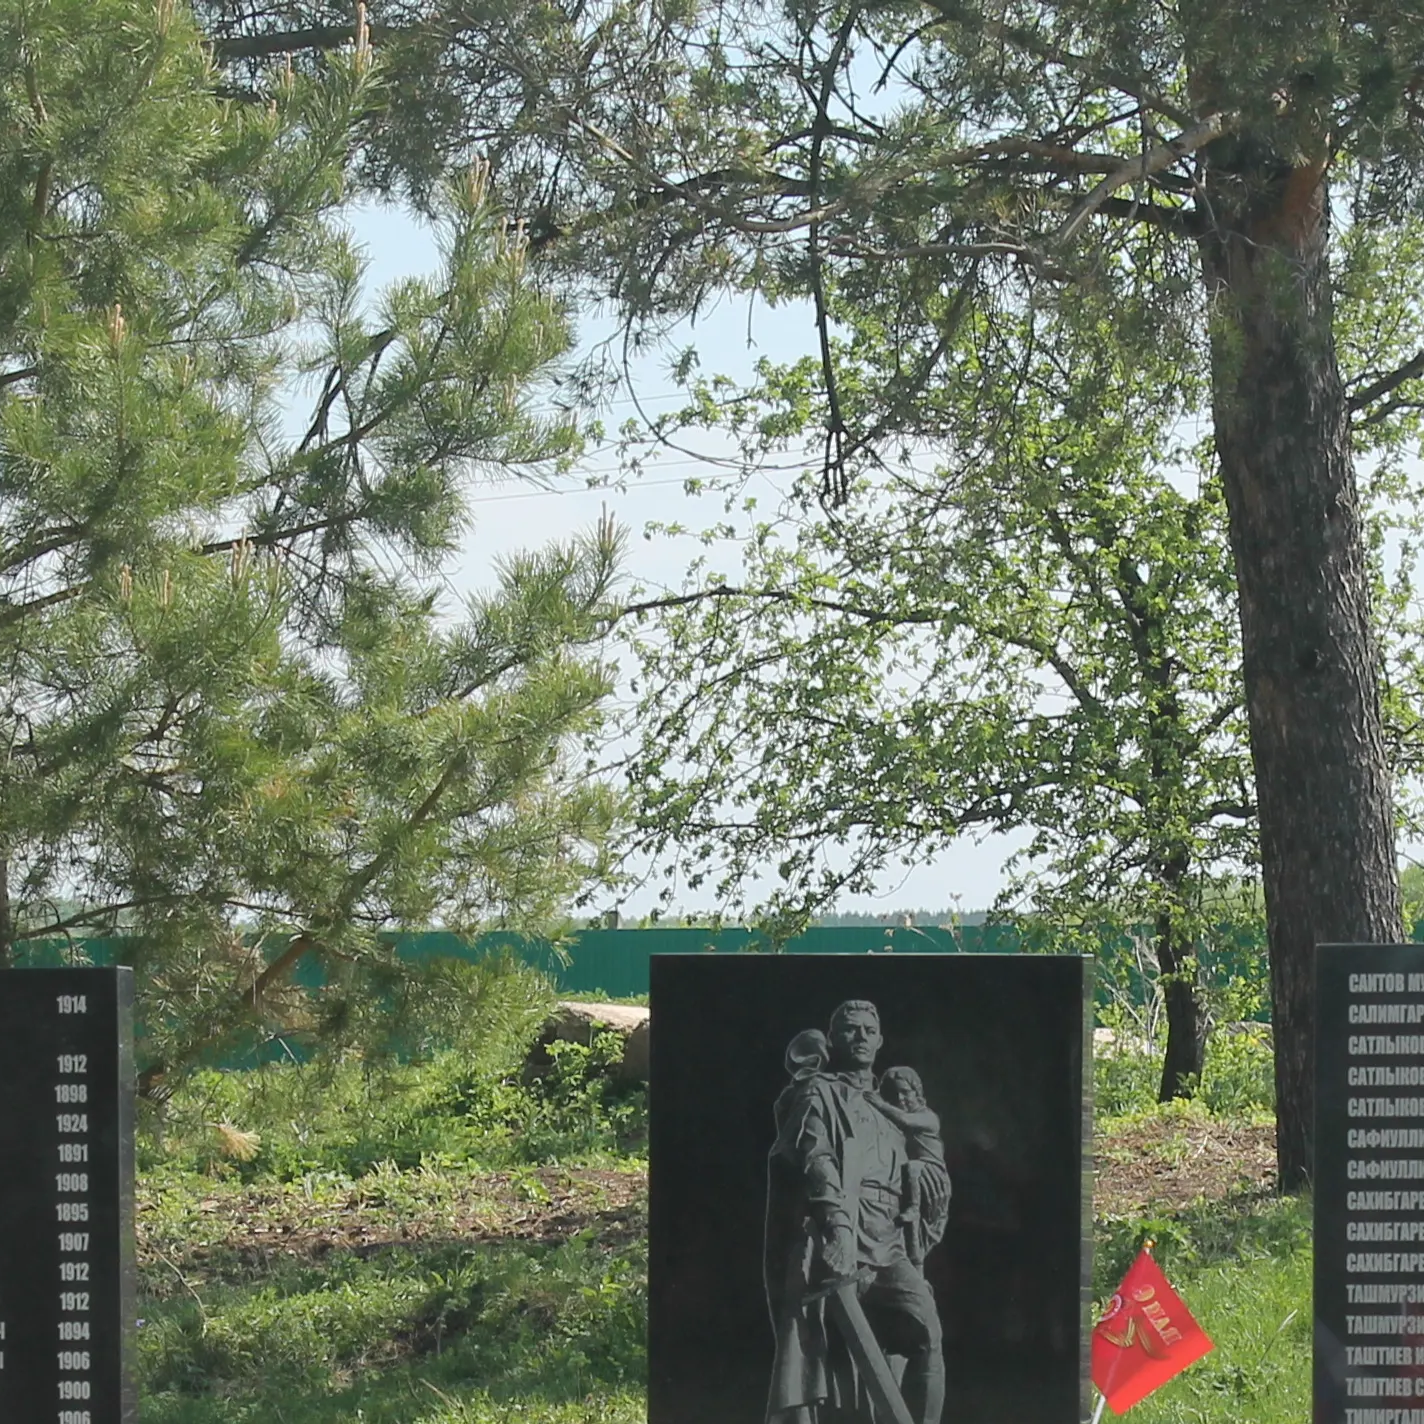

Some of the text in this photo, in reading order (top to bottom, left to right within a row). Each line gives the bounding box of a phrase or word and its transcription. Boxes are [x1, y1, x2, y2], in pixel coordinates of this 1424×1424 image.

[57, 995, 86, 1013] 1914
[57, 1114, 88, 1132] 1924
[56, 1173, 88, 1191] 1908
[59, 1233, 89, 1251] 1907
[58, 1351, 90, 1370] 1906
